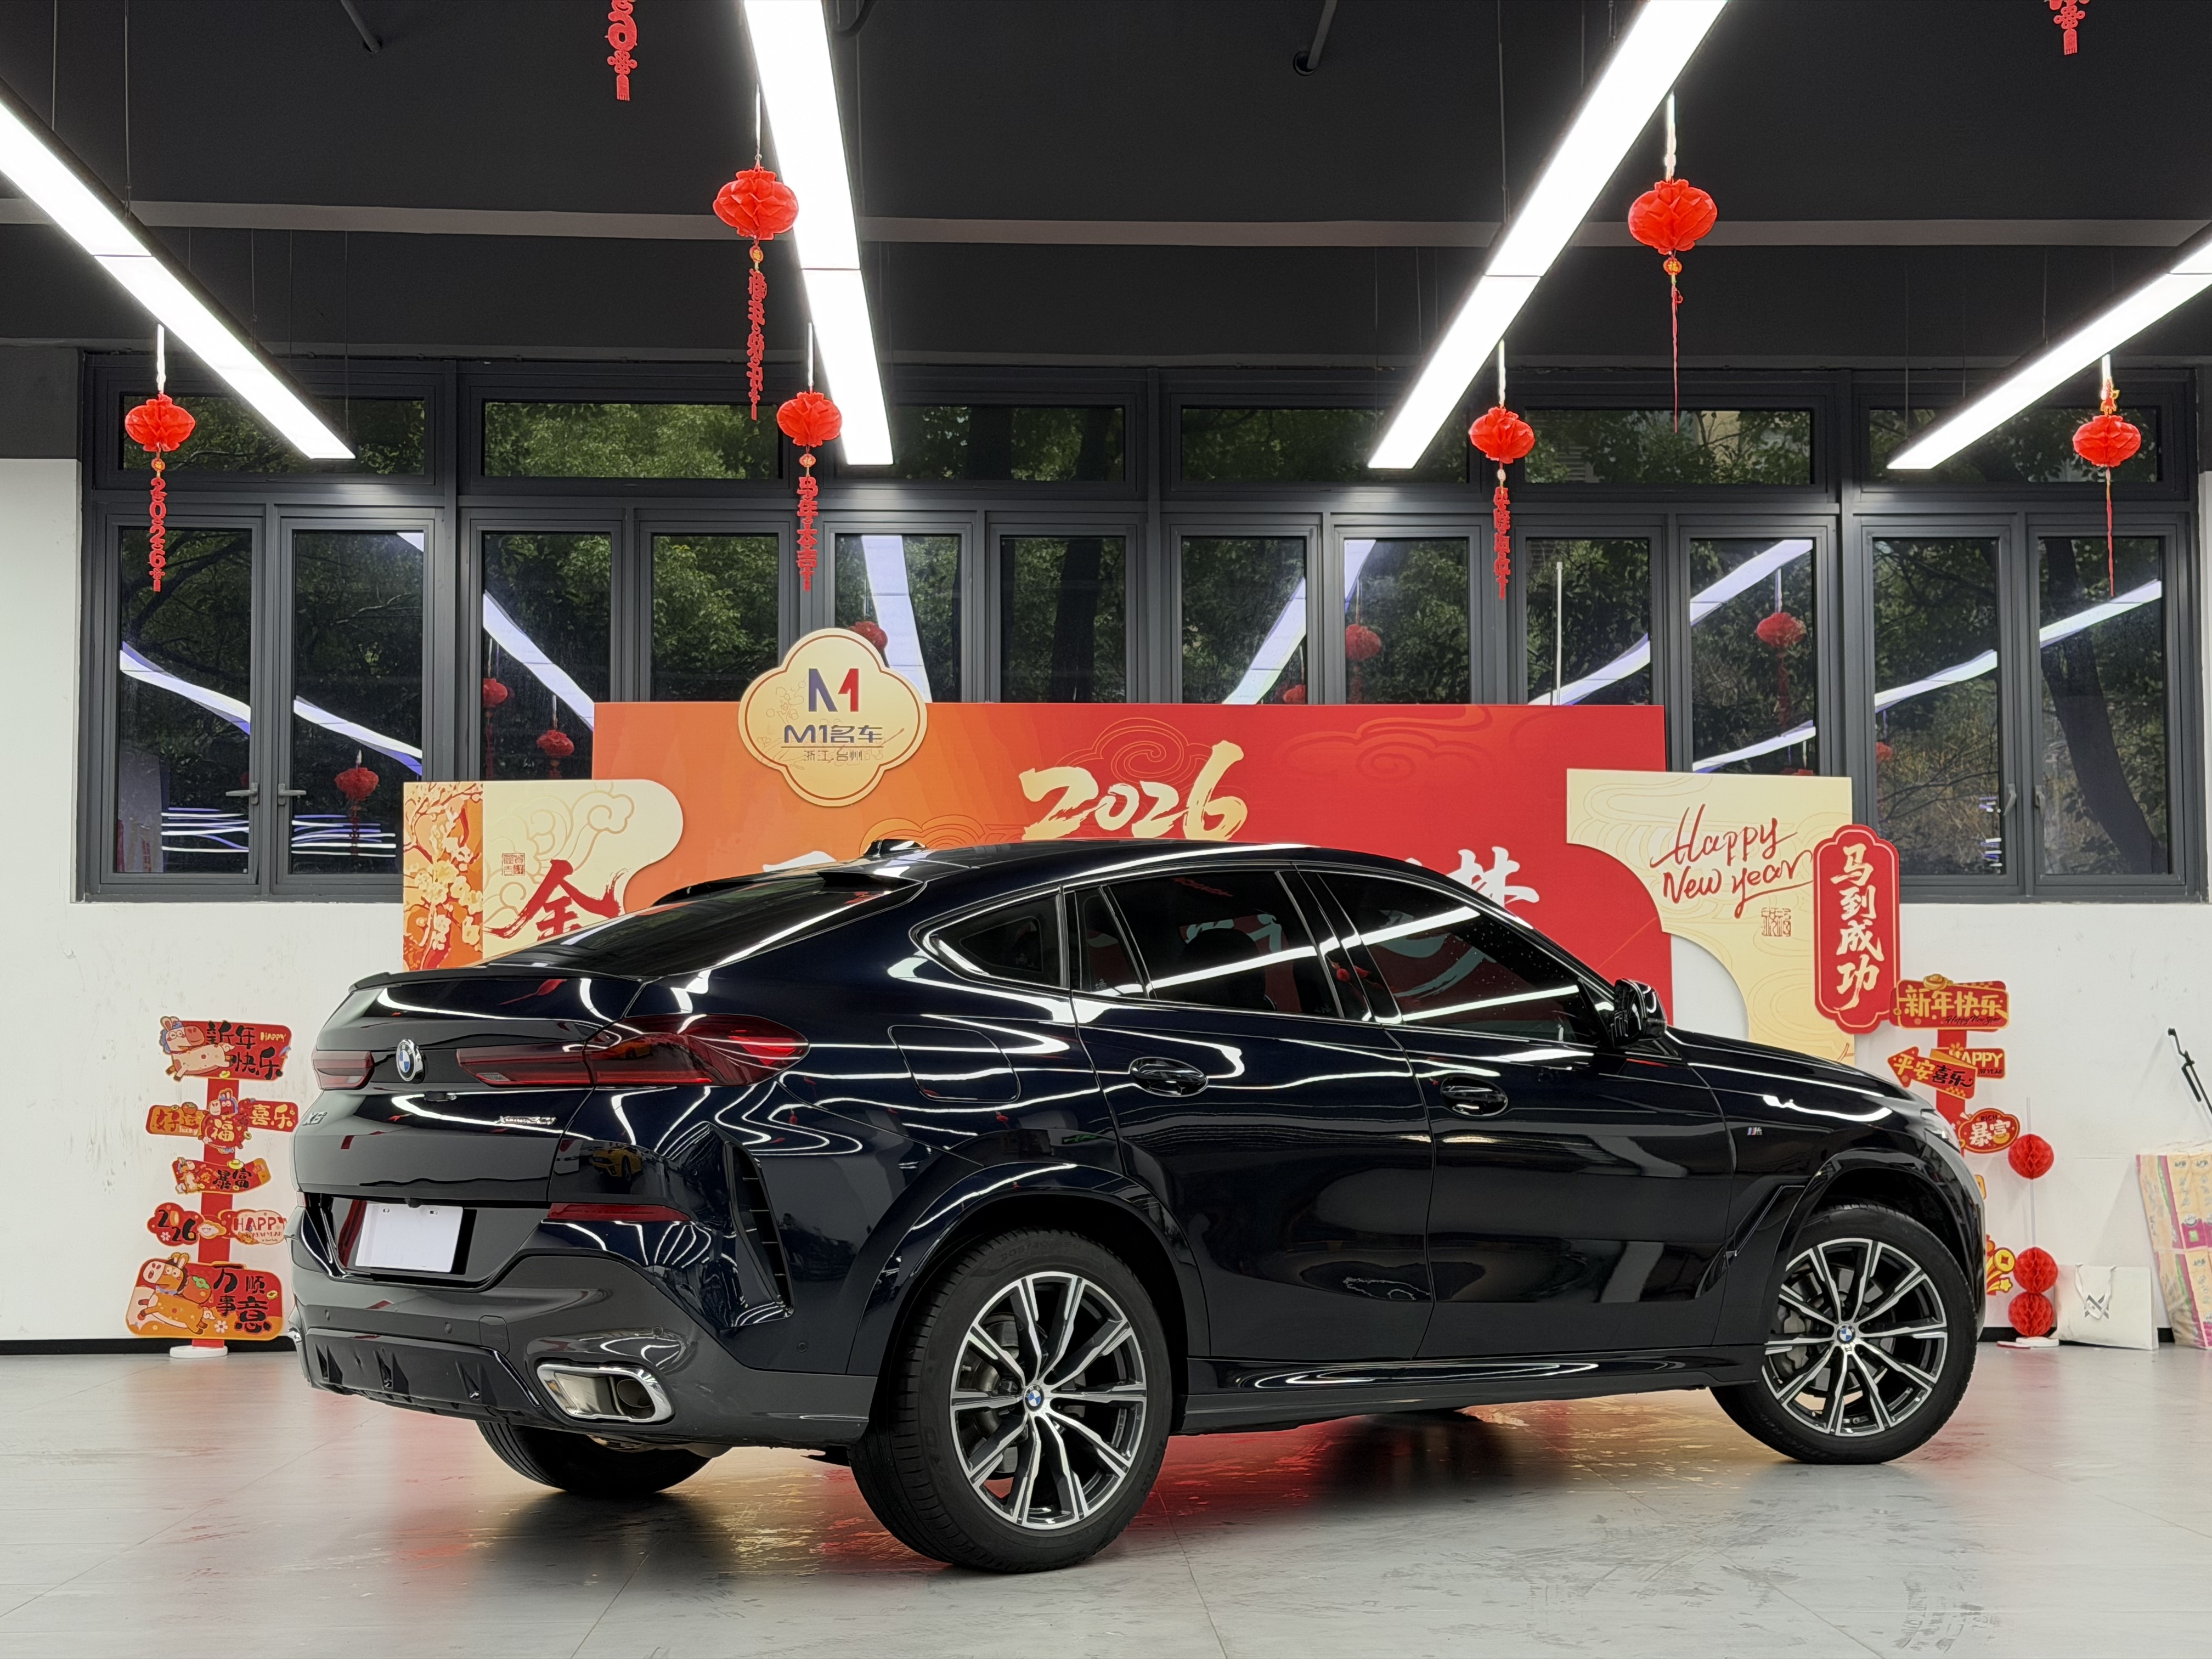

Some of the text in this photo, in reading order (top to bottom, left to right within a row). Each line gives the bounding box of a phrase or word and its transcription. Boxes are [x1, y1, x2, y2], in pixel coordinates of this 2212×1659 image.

[796, 476, 819, 568] 马年大吉
[784, 724, 883, 743] M1名车
[1018, 740, 1248, 841] 2026
[1649, 804, 1798, 868] Happy
[1663, 849, 1814, 919] New year
[1830, 843, 1884, 1012] 马到成功
[1904, 984, 2002, 1017] 新年快乐
[206, 1020, 256, 1049] 新年
[260, 1031, 287, 1041] HAPPY
[232, 1047, 283, 1080] 快乐
[1893, 1053, 1974, 1087] 平安喜乐
[156, 1109, 199, 1132] 好运
[211, 1119, 235, 1142] 福
[250, 1104, 293, 1130] 喜乐
[212, 1167, 252, 1190] 暴富
